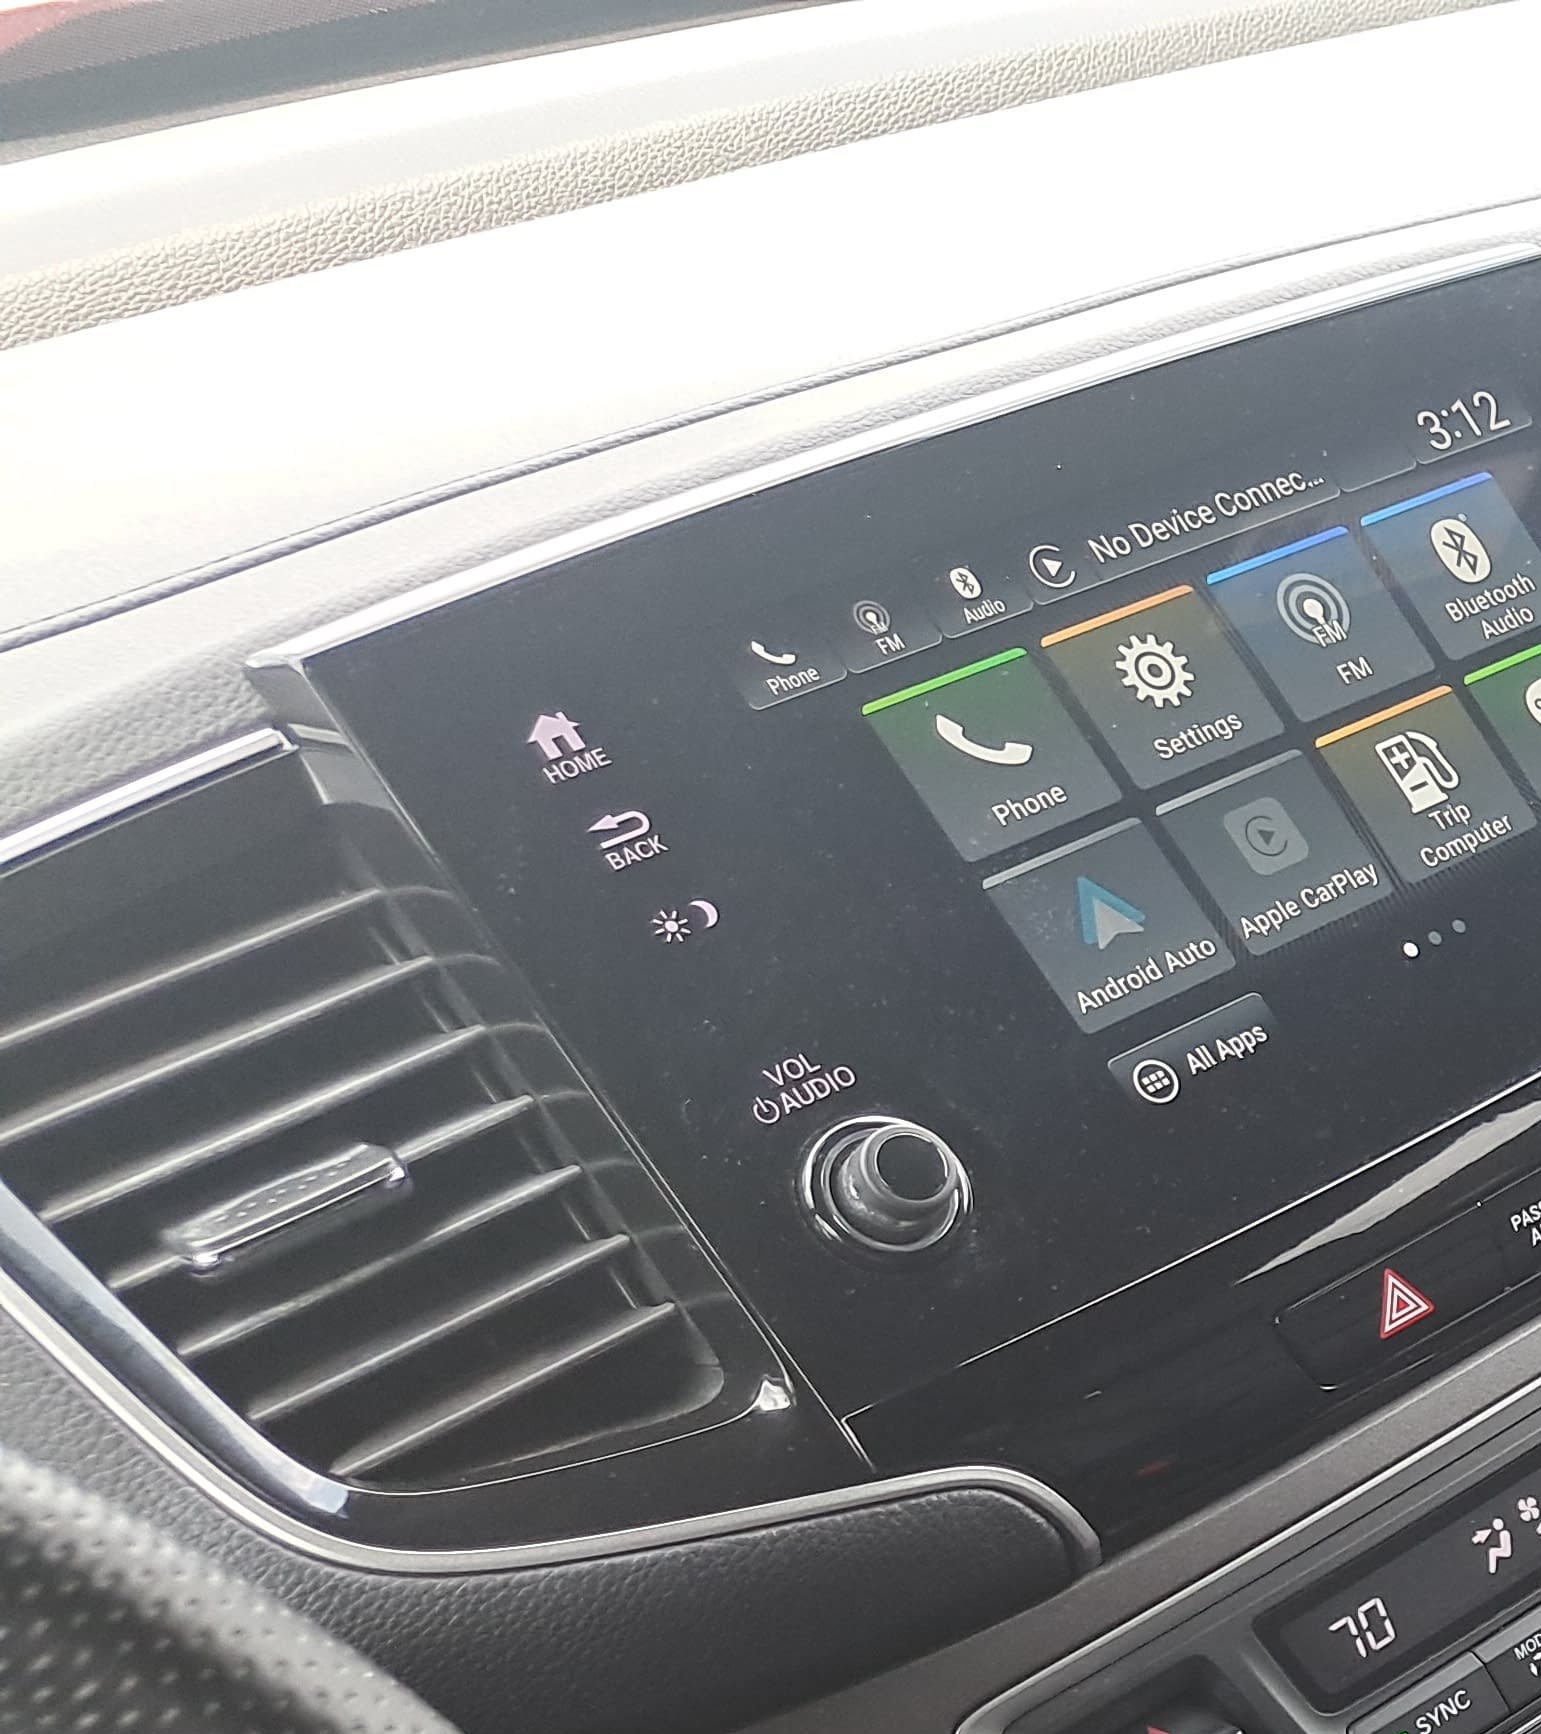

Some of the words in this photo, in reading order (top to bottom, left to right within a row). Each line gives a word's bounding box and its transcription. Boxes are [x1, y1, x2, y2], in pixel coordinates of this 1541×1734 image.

[1415, 390, 1511, 451] 3:12
[1087, 532, 1131, 564] No
[1127, 504, 1217, 551] Device
[1212, 472, 1325, 522] Connec...
[963, 598, 1005, 626] Audio
[1444, 572, 1536, 623] Bluetooth
[875, 635, 906, 656] FM
[1481, 605, 1534, 641] Audio
[766, 664, 820, 696] Phone
[1336, 656, 1374, 686] FM
[1153, 712, 1243, 760] Settings
[543, 747, 612, 784] HOME
[991, 785, 1067, 827] Phone
[1429, 803, 1471, 832] Trip
[604, 834, 668, 871] BACK
[1419, 814, 1513, 868] Computer
[1239, 898, 1302, 940] Apple
[1300, 861, 1380, 910] CarPlay
[1076, 955, 1163, 1014] Android
[1165, 937, 1217, 977] Auto
[762, 1053, 822, 1090] VOL
[1184, 1041, 1217, 1076] All
[1215, 1024, 1269, 1063] Apps
[780, 1065, 857, 1116] AUDIO
[1328, 1597, 1397, 1658] 70
